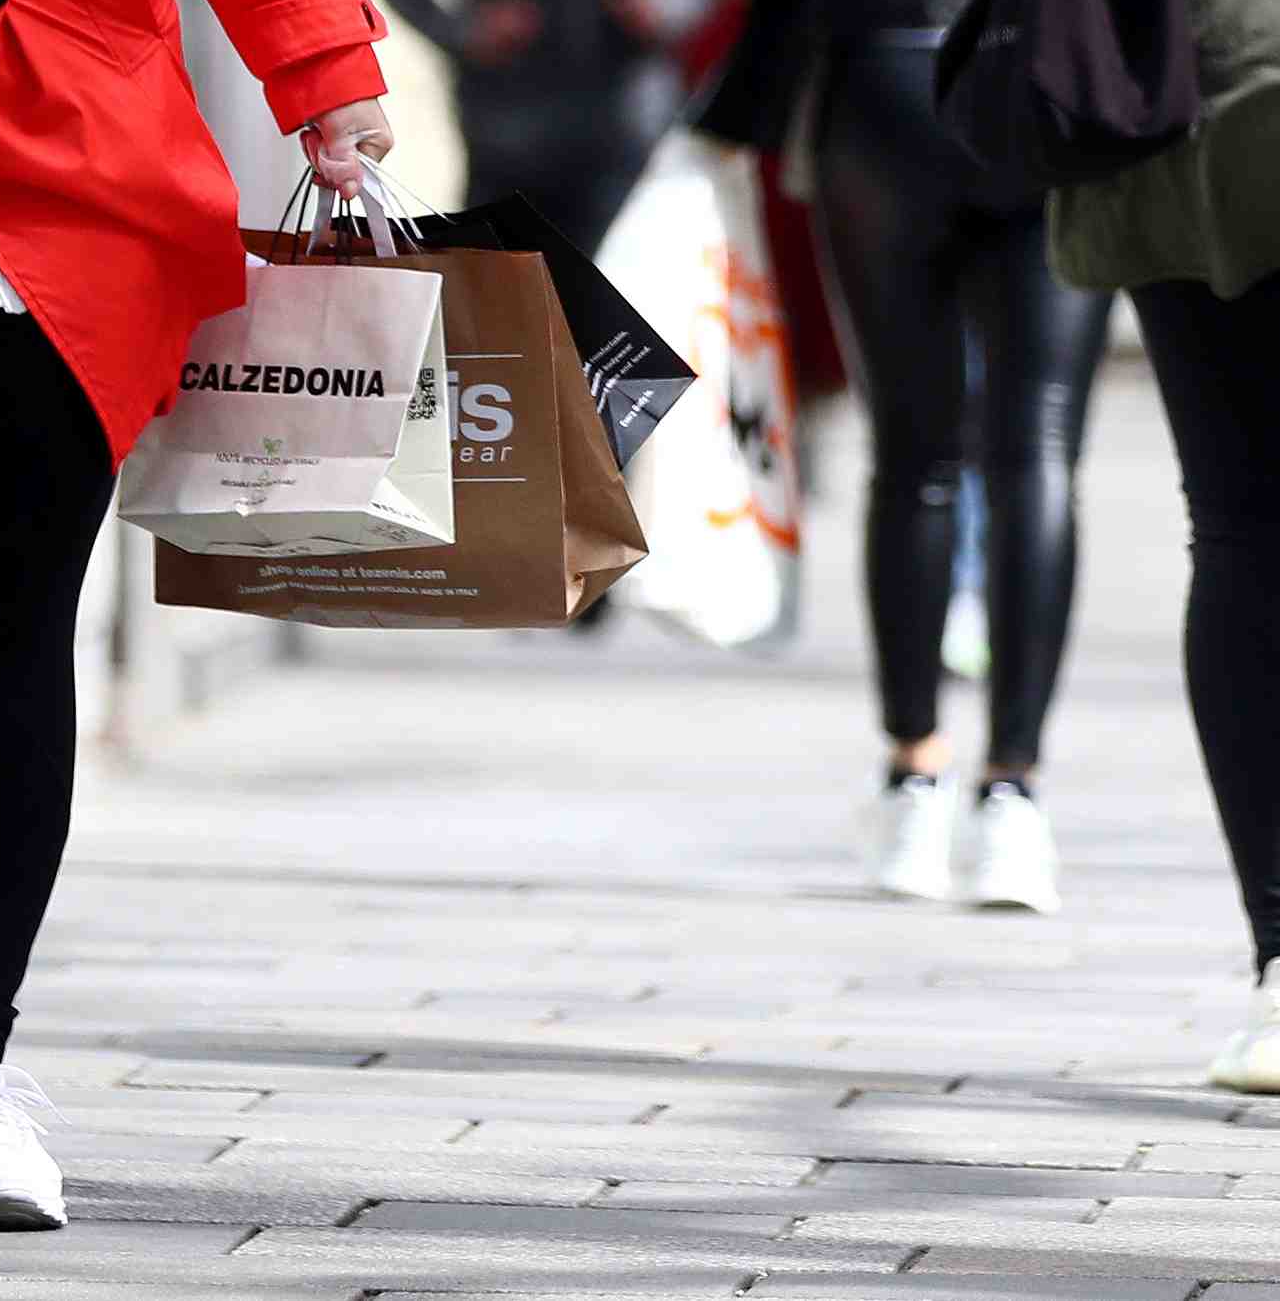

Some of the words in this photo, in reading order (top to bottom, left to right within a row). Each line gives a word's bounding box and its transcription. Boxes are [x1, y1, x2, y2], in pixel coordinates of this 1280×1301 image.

[179, 362, 385, 398] CALZEDONIA
[296, 565, 338, 579] online
[341, 566, 358, 578] at
